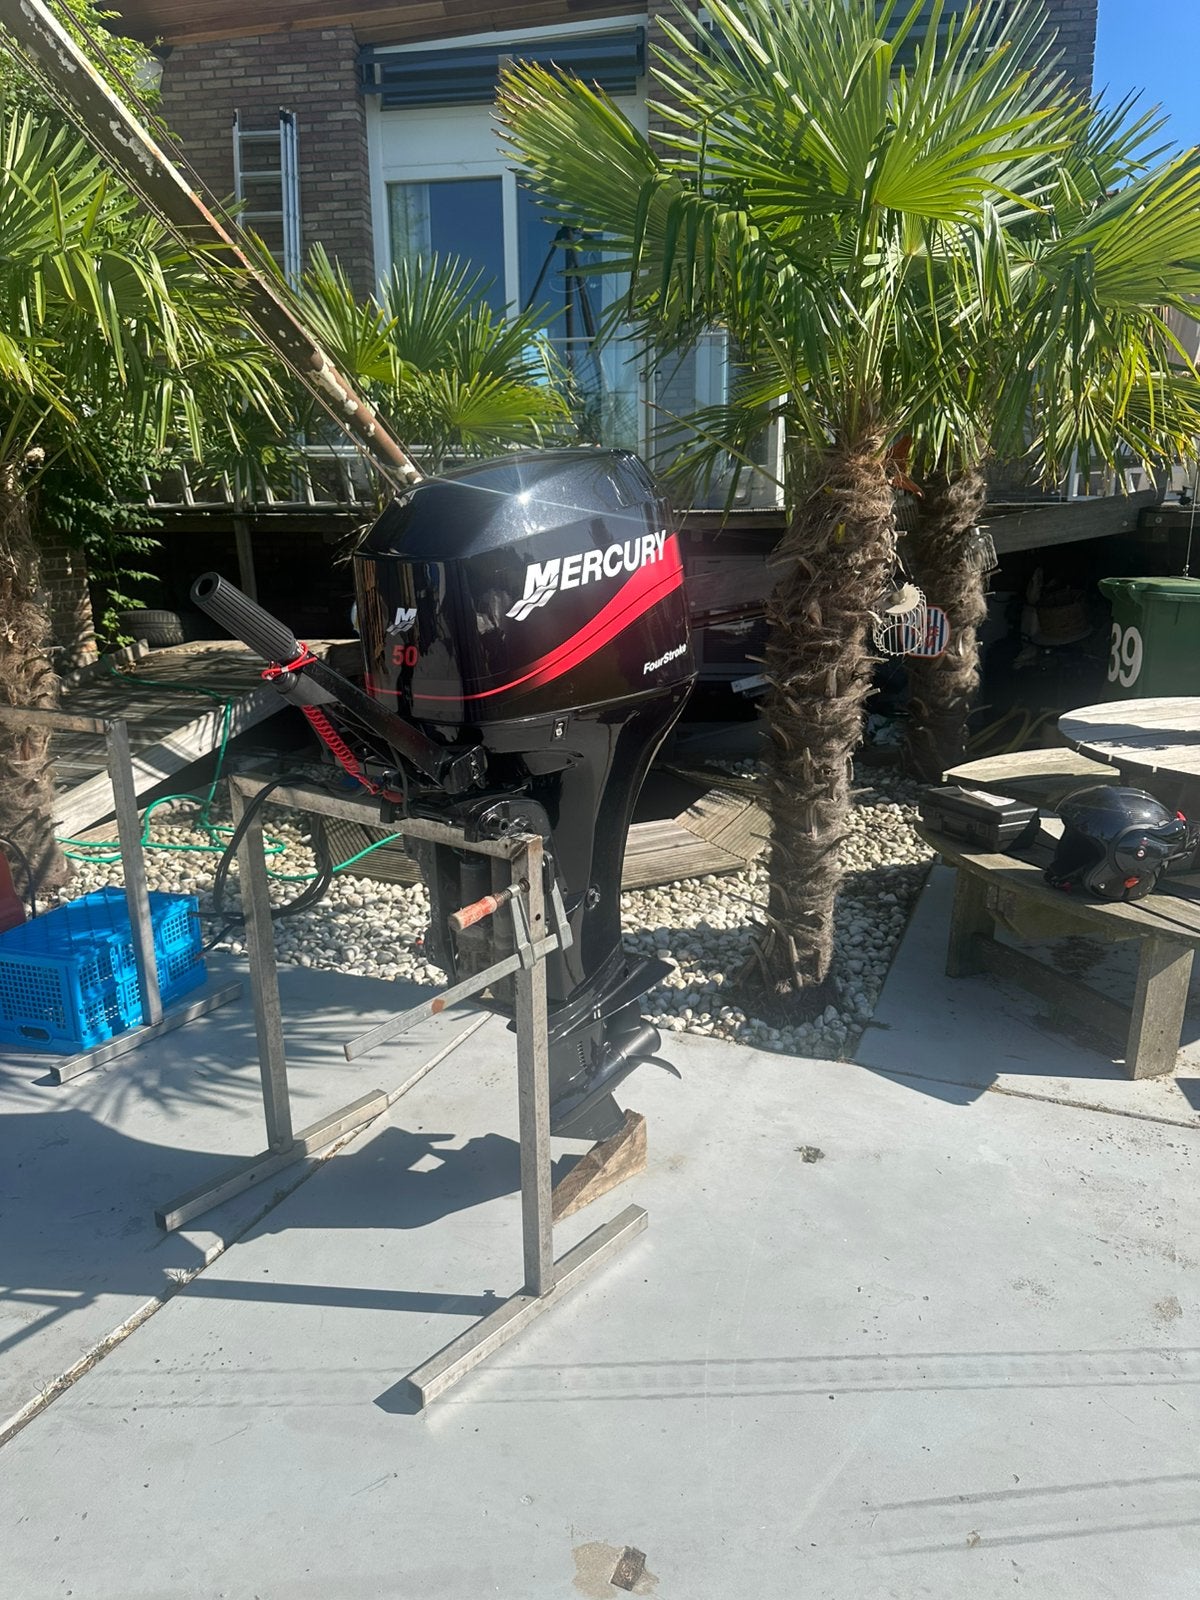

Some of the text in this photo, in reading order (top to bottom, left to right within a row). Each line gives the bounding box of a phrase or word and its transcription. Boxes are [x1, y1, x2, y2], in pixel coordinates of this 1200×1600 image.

[522, 530, 666, 600] MERCURY
[392, 645, 418, 667] 50
[1108, 622, 1143, 688] 39
